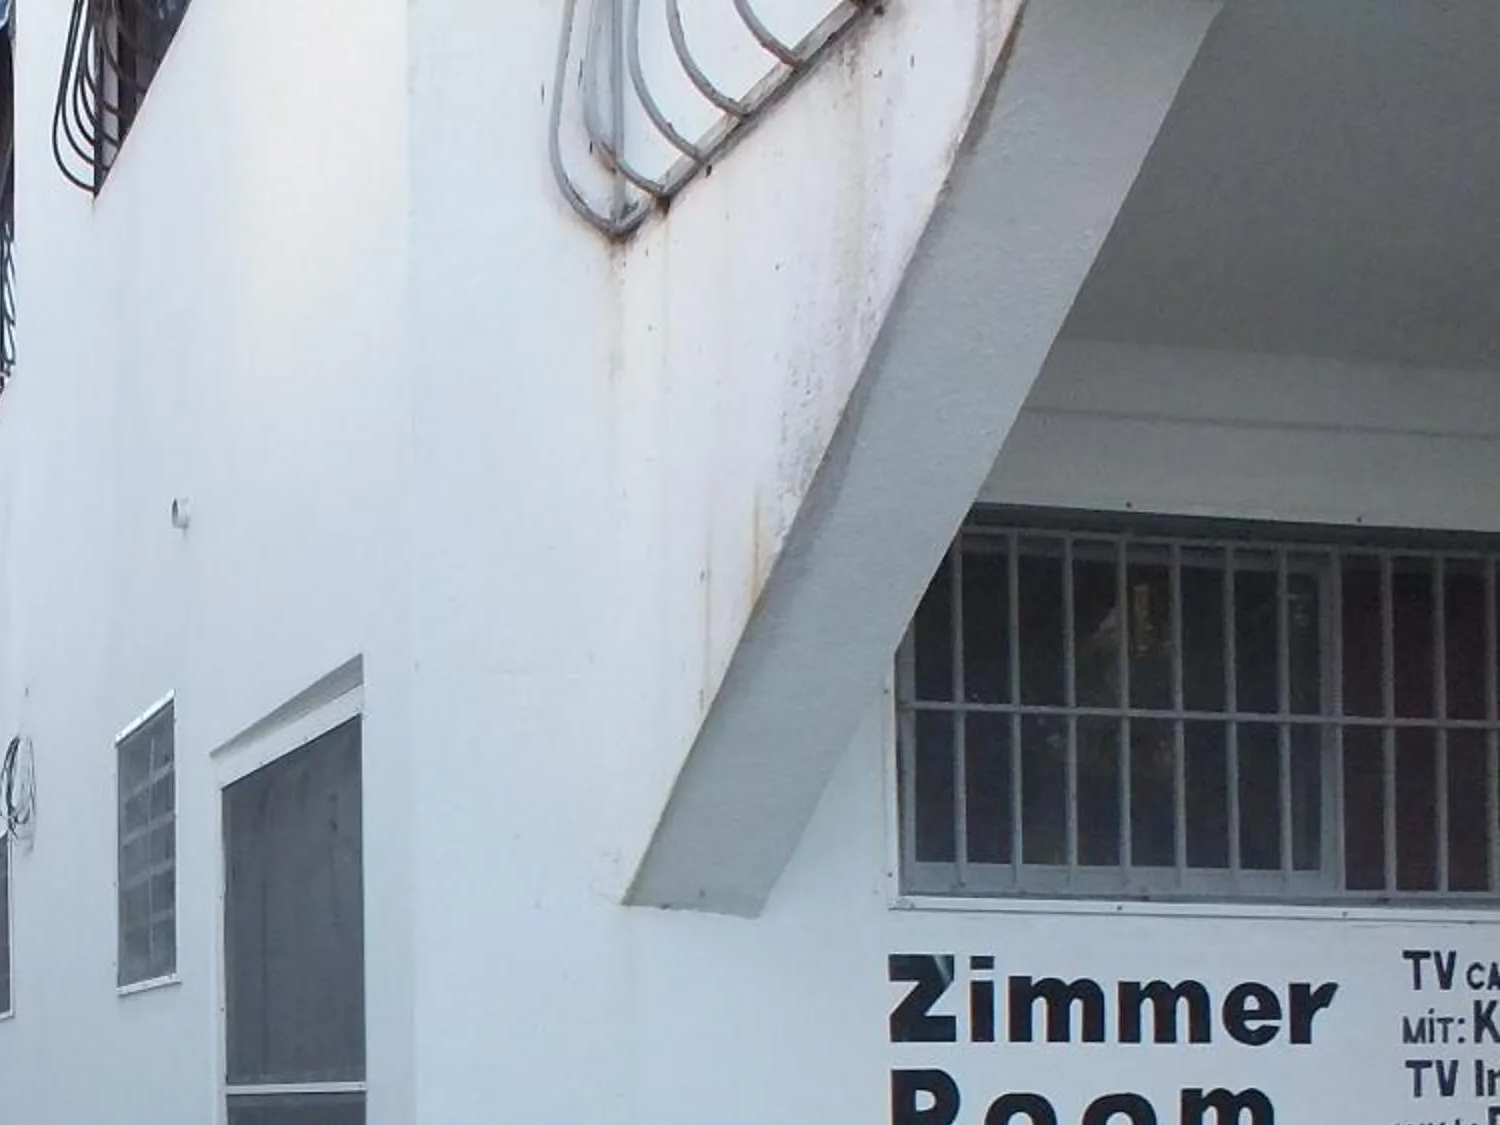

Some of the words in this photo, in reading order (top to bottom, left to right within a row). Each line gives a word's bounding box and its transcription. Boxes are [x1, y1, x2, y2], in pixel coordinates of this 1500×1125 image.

[1402, 950, 1457, 990] TV
[887, 954, 1339, 1046] Zimmer
[1405, 1060, 1459, 1098] TV
